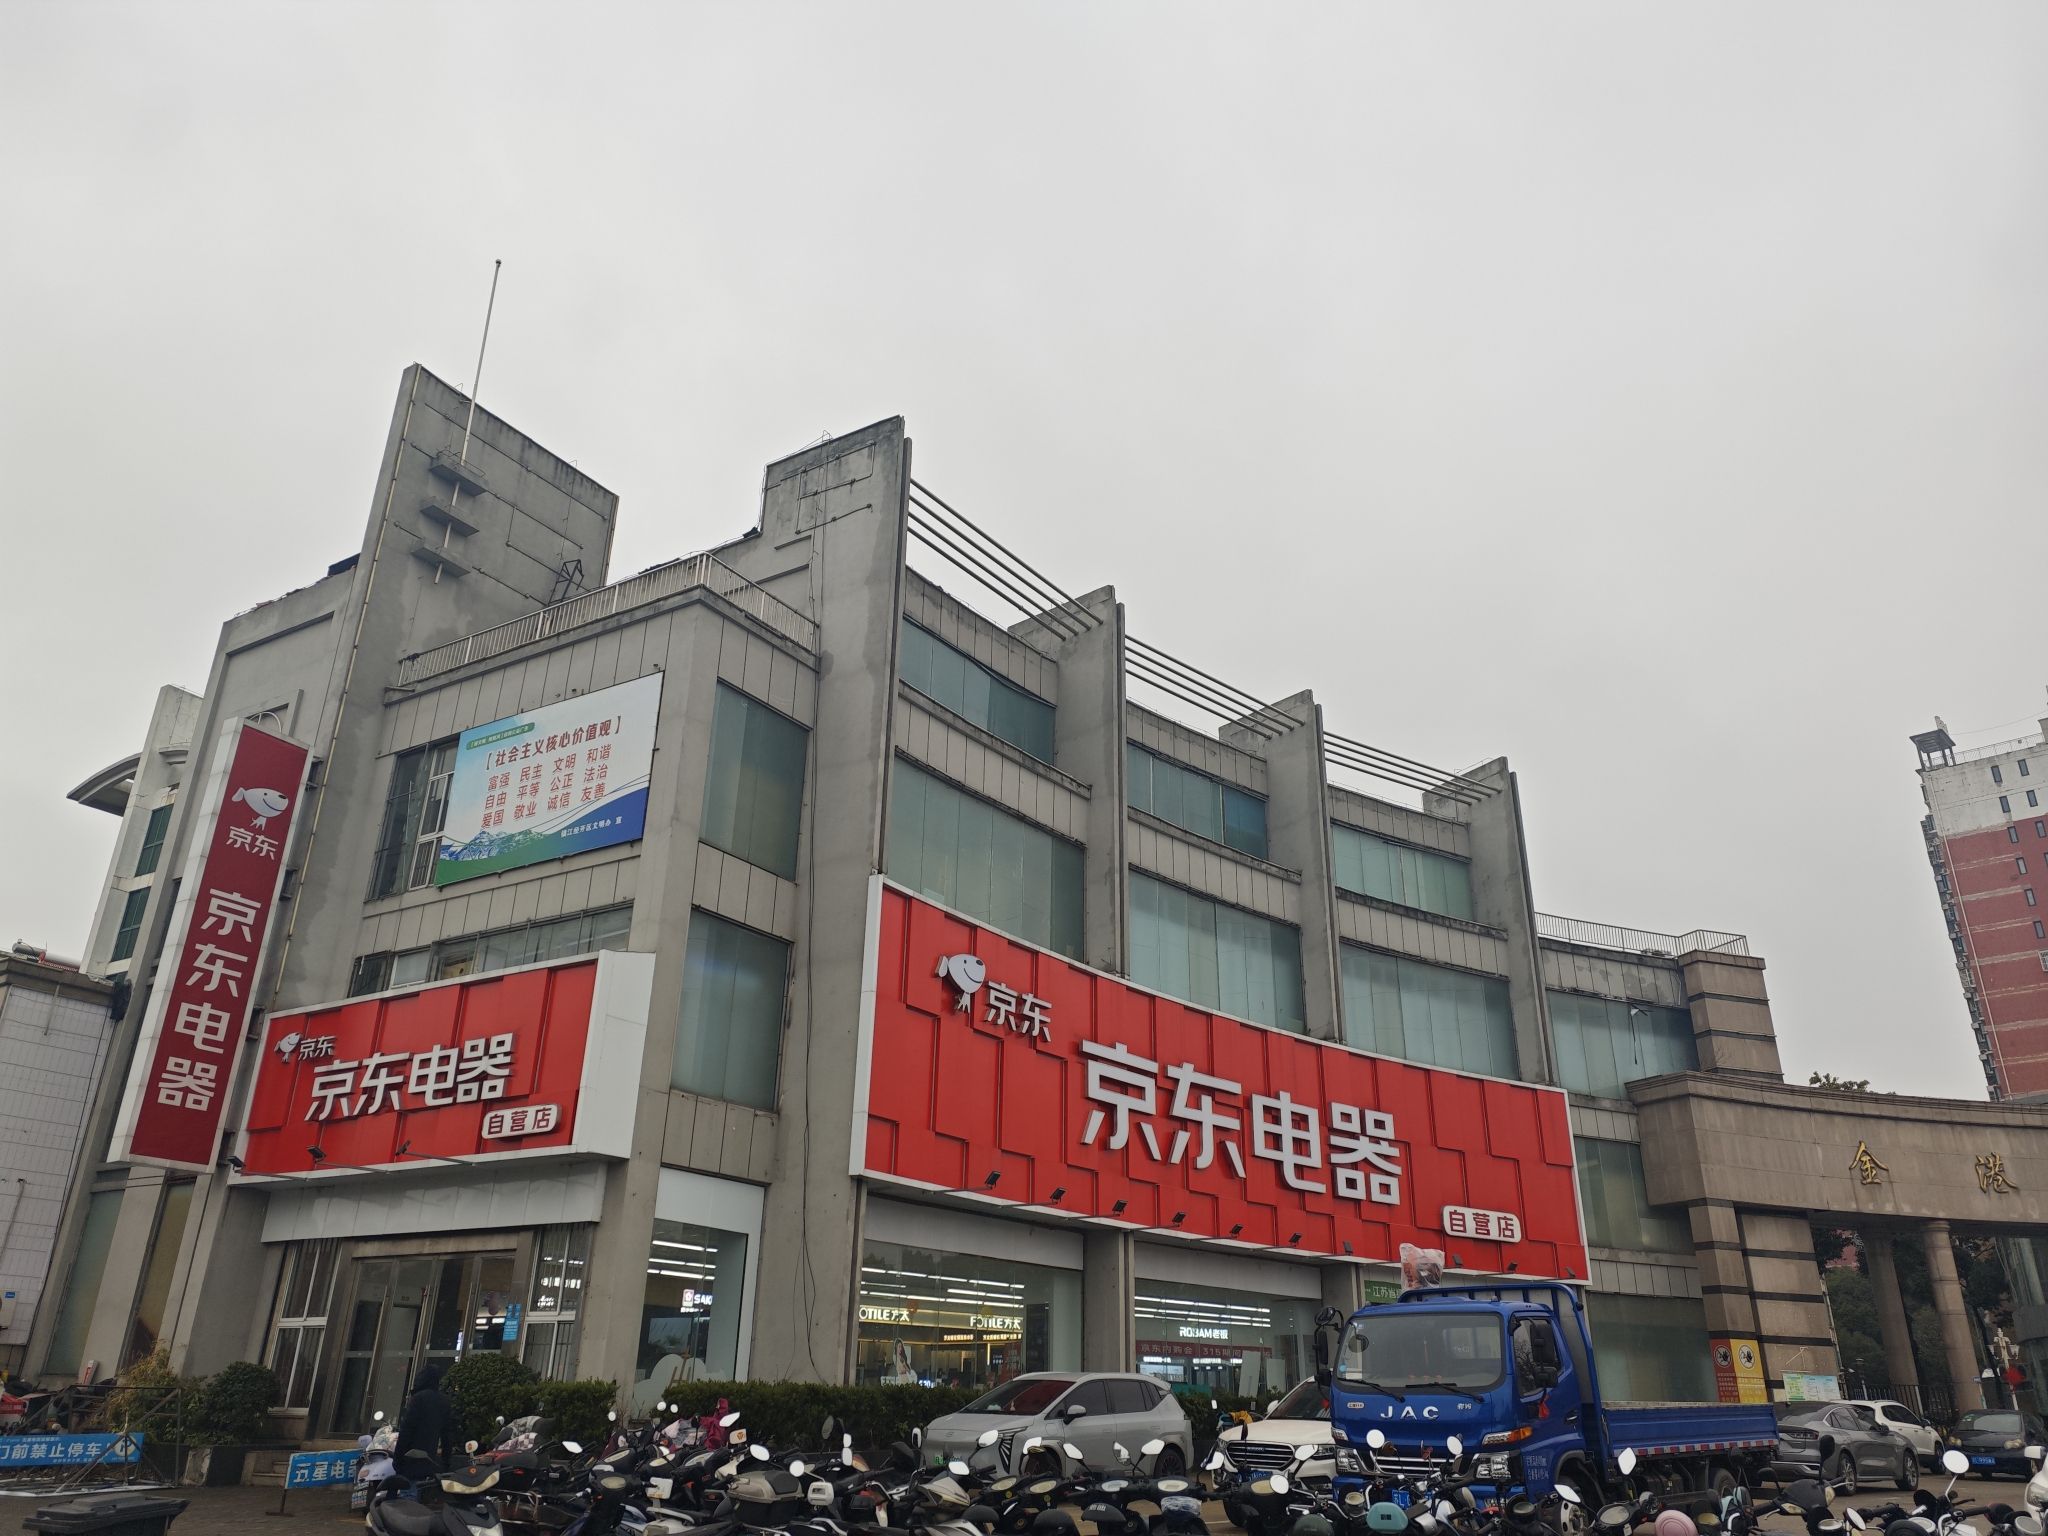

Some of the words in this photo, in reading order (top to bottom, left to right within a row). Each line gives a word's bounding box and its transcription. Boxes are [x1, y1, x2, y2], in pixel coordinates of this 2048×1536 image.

[485, 791, 507, 810] 自由
[517, 781, 540, 801] 平等
[550, 772, 574, 792] 公正
[583, 763, 608, 783] 法治
[487, 771, 511, 791] 富强
[519, 763, 543, 783] 民主
[552, 753, 576, 774] 文明
[586, 743, 612, 764] 和谐
[481, 809, 504, 829] 爱国
[513, 801, 537, 821] 敬业
[547, 791, 571, 812] 诚信
[580, 782, 606, 803] 友善
[226, 826, 279, 860] 京东
[157, 888, 262, 1112] 京东电器
[985, 981, 1052, 1042] 京东
[298, 1035, 336, 1060] 京东
[304, 1032, 514, 1121] 京东电器
[487, 1107, 551, 1136] 自营店
[1080, 1039, 1402, 1205] 京东电器
[1449, 1209, 1515, 1240] 自营店
[1380, 1405, 1439, 1420] JAC
